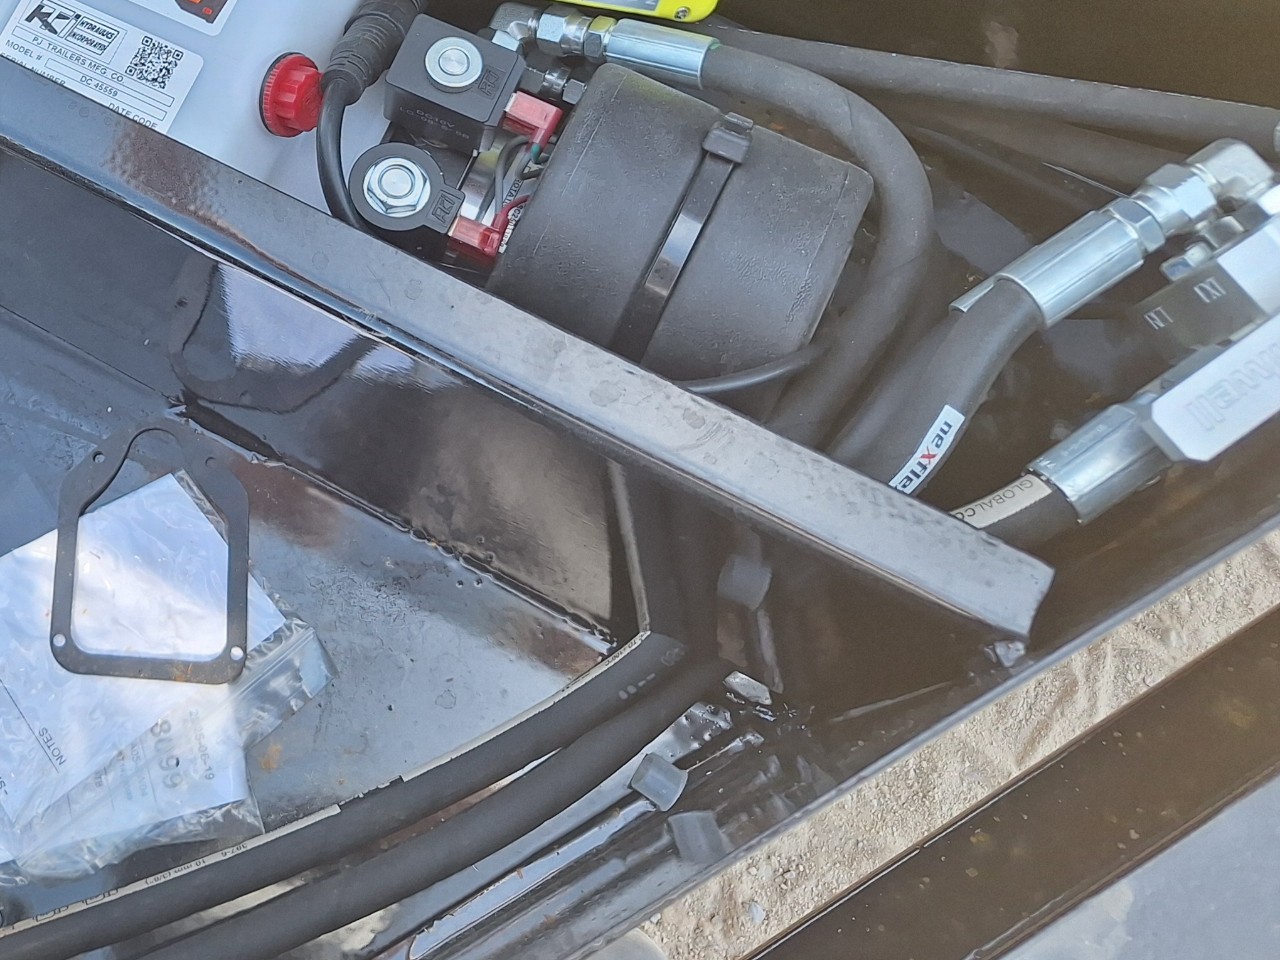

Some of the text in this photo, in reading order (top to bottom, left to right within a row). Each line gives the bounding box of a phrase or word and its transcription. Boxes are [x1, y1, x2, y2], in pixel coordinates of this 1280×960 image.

[4, 38, 43, 62] MODEL #
[31, 35, 126, 84] PJ TRAILERS MFG. CO.
[79, 73, 118, 98] DC 45559
[36, 725, 68, 765] NOTES
